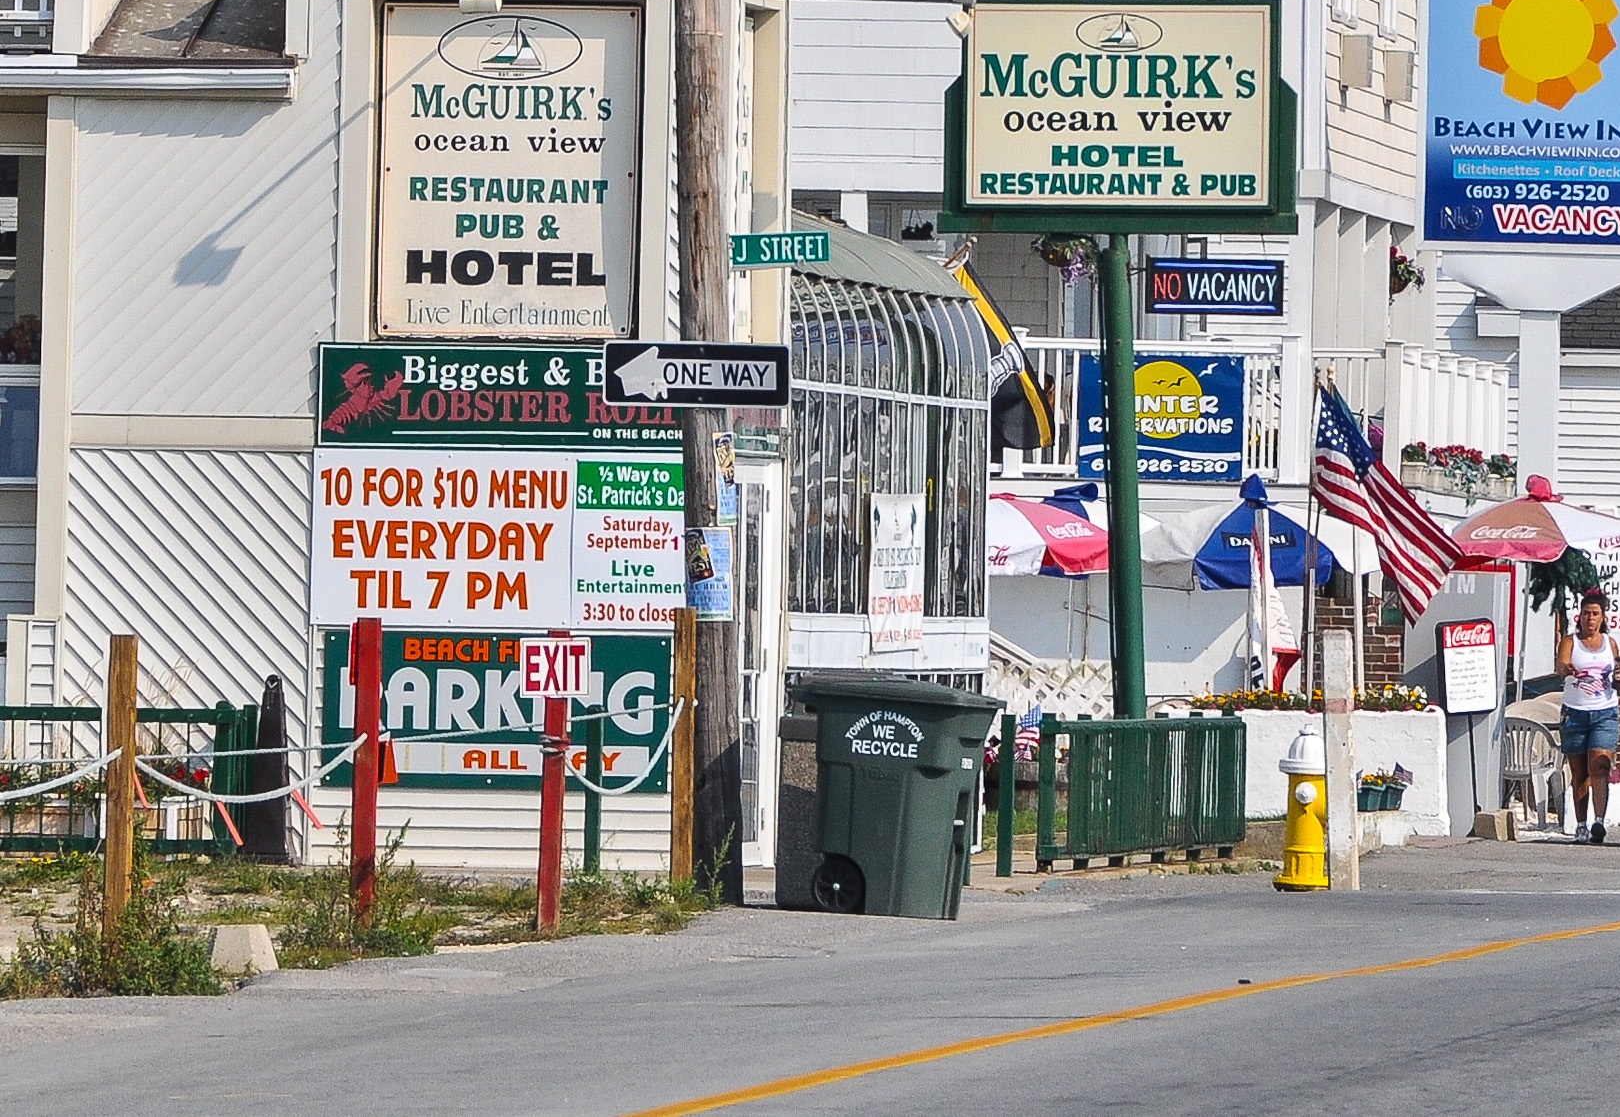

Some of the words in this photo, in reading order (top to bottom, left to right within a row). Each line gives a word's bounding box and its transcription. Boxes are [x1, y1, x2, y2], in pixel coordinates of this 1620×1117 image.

[1003, 110, 1118, 132] ocean
[1138, 101, 1232, 133] view
[414, 134, 510, 152] ocean
[527, 127, 607, 153] view
[1051, 145, 1184, 167] HOTEL
[1457, 163, 1540, 176] Kitchenettes
[1554, 166, 1585, 177] Roof
[1589, 167, 1620, 178] Deck
[409, 177, 609, 205] RESTAURANT
[980, 173, 1162, 196] RESTAURANT
[1171, 174, 1189, 196] &
[1200, 174, 1256, 196] PUB
[1465, 185, 1509, 200] (603)
[1515, 183, 1609, 202] 926-2520
[455, 214, 524, 238] PUB
[538, 215, 560, 239] &
[735, 238, 747, 262] J
[760, 235, 825, 261] STREET
[406, 250, 606, 286] HOTEL
[1154, 273, 1181, 301] NO
[1187, 273, 1277, 302] VACANCY
[405, 300, 450, 326] Live
[460, 300, 612, 328] Entertainment
[402, 356, 529, 391] Biggest
[543, 358, 570, 384] &
[662, 362, 713, 386] ONE
[721, 363, 770, 387] WAY
[397, 389, 571, 423] LOBSTER
[592, 428, 610, 439] ON
[616, 428, 638, 439] THE
[321, 469, 352, 506] 10
[362, 469, 421, 507] FOR
[433, 468, 478, 508] $10
[488, 469, 567, 509] MENU
[616, 466, 648, 486] Way
[652, 469, 670, 482] to
[577, 485, 598, 505] St.
[601, 485, 663, 506] Patrick's
[603, 516, 673, 534] Saturday,
[331, 519, 554, 561] EVERYDAY
[587, 533, 668, 552] September
[611, 560, 655, 576] Live
[349, 571, 412, 609] TIL
[427, 572, 450, 609] 7
[465, 573, 528, 610] PM
[583, 603, 615, 621] 3:30
[620, 605, 635, 620] to
[404, 638, 490, 662] BEACH
[525, 645, 586, 691] EXIT
[845, 716, 870, 740] TOWN
[869, 711, 882, 722] OF
[883, 711, 925, 743] HAMPTON
[872, 725, 896, 740] WE
[463, 750, 527, 770] ALL
[851, 739, 918, 759] RECYCLE
